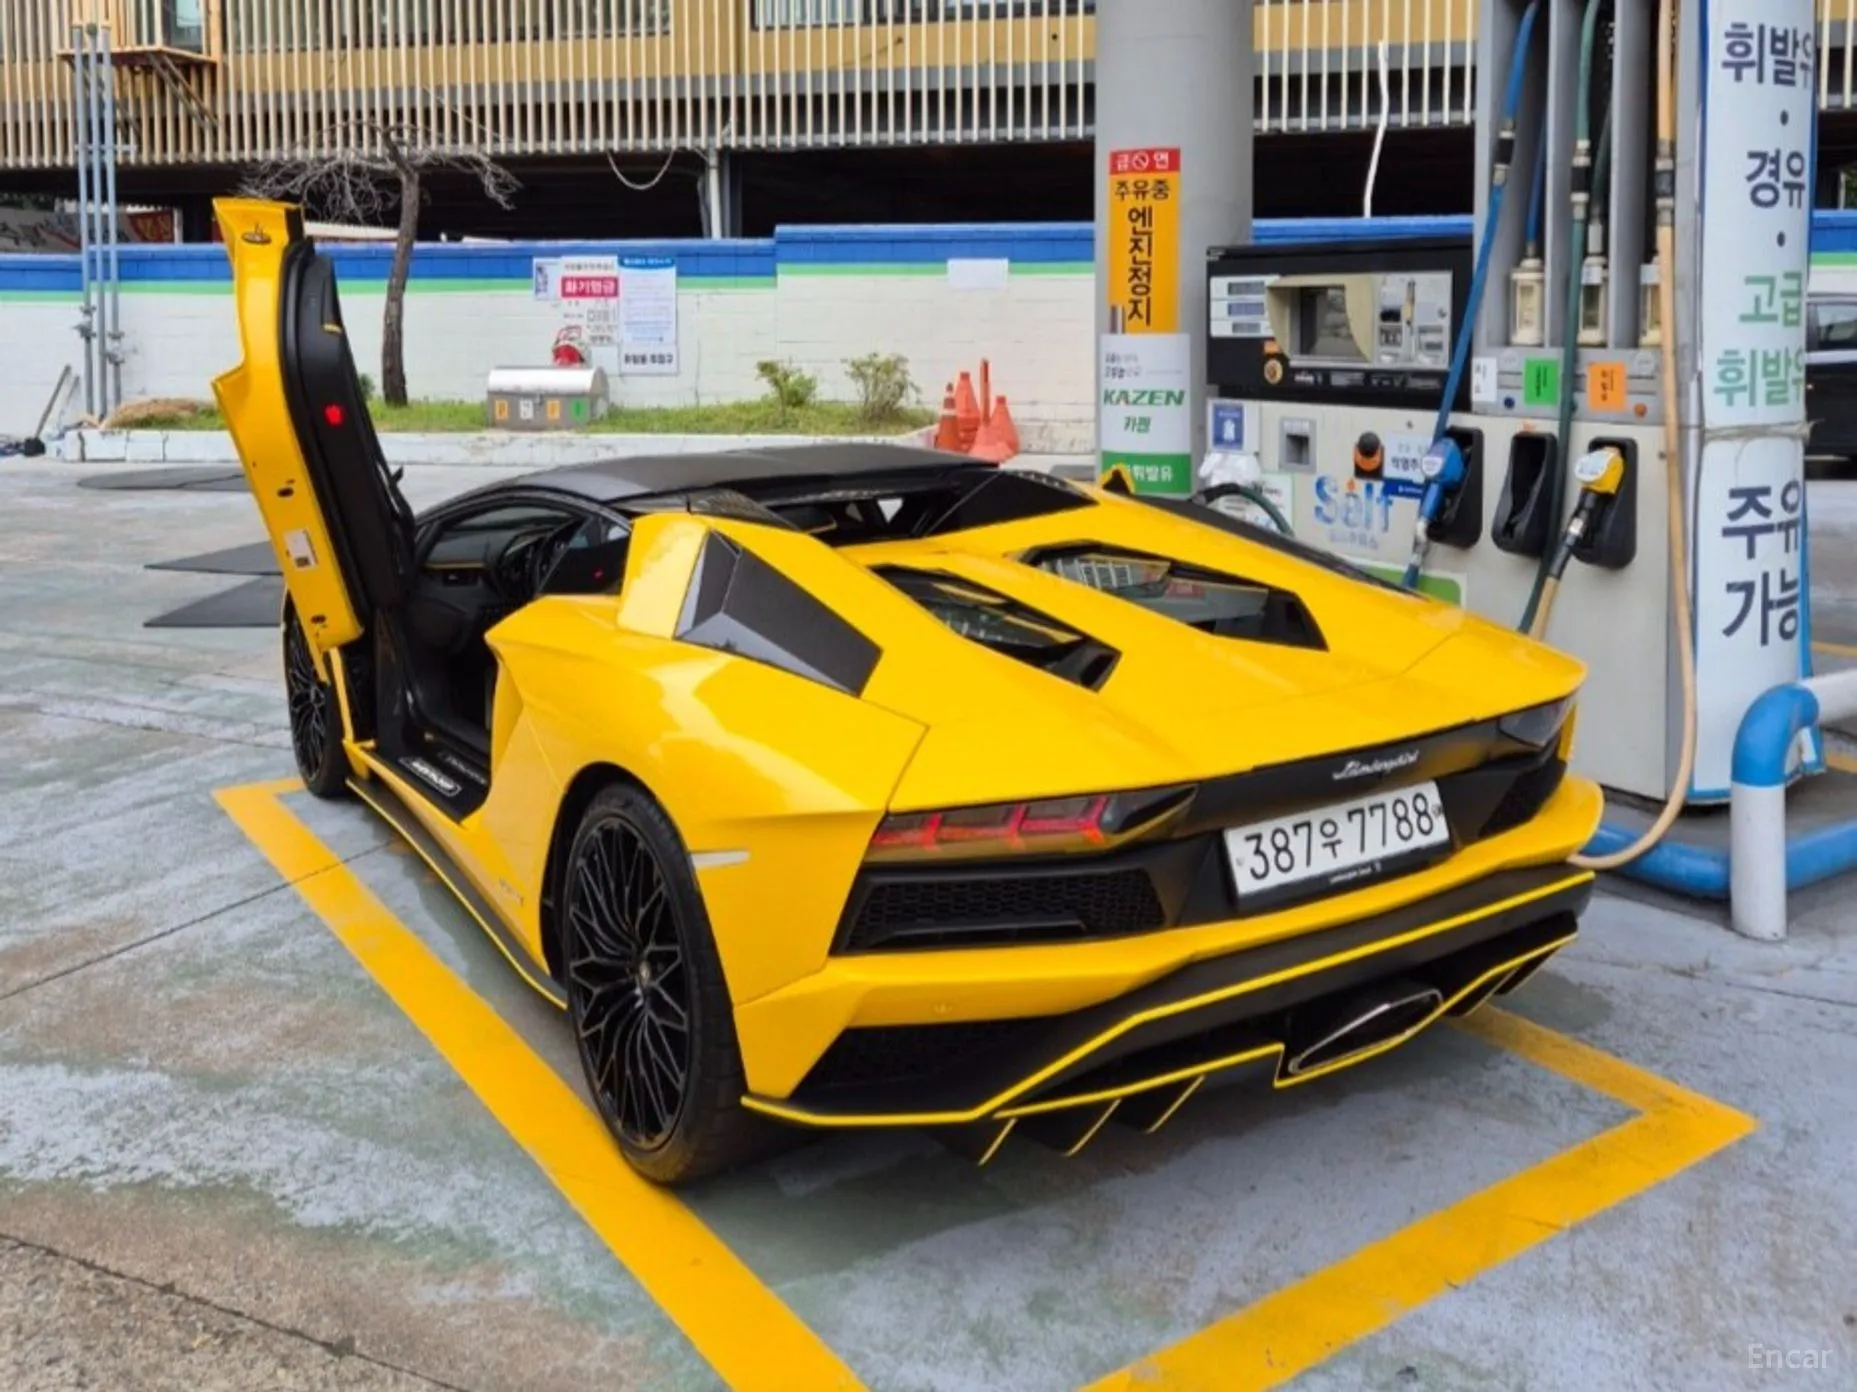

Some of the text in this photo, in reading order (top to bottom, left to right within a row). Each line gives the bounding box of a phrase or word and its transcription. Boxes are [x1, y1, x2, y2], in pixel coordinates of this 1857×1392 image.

[1115, 180, 1170, 201] 주유중
[1116, 153, 1130, 171] 금
[1745, 149, 1805, 209] 경유
[1127, 204, 1154, 327] 엔진정지
[1103, 389, 1185, 406] KAZEN
[1314, 474, 1393, 533] Self
[1721, 480, 1800, 560] 주유
[1721, 568, 1800, 646] 가능
